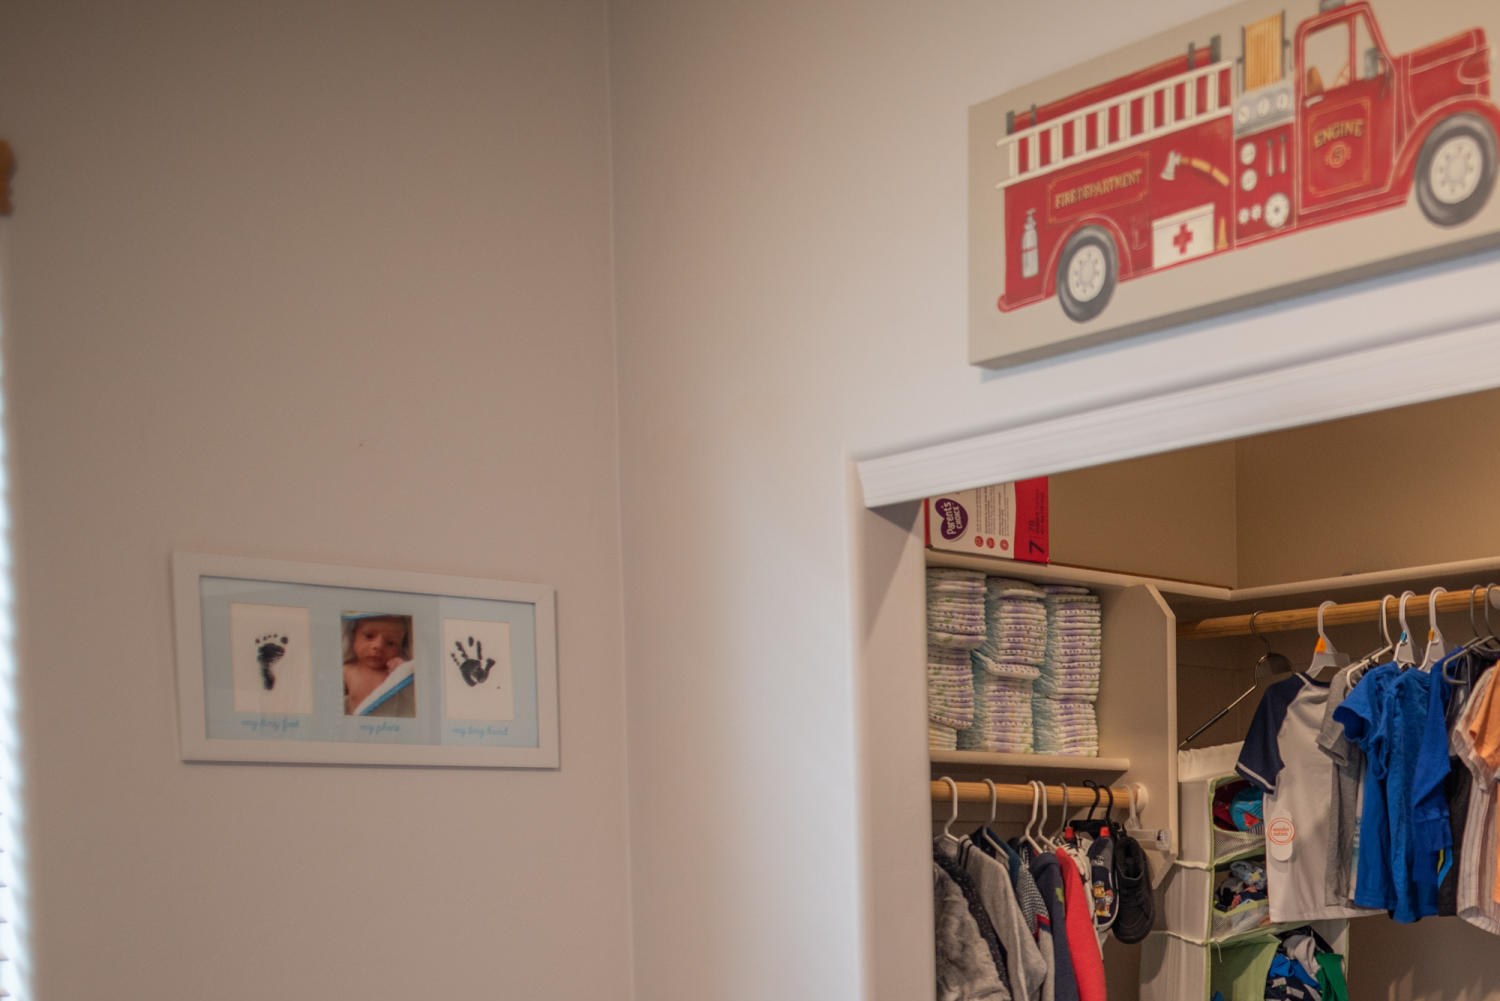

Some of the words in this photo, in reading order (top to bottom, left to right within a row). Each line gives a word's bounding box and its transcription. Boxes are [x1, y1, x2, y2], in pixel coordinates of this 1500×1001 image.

[1313, 119, 1365, 149] ENGINE
[1077, 168, 1142, 205] DEPARTMENT
[944, 502, 956, 535] Parent's
[954, 505, 963, 530] CHOICE
[1029, 540, 1045, 554] 7
